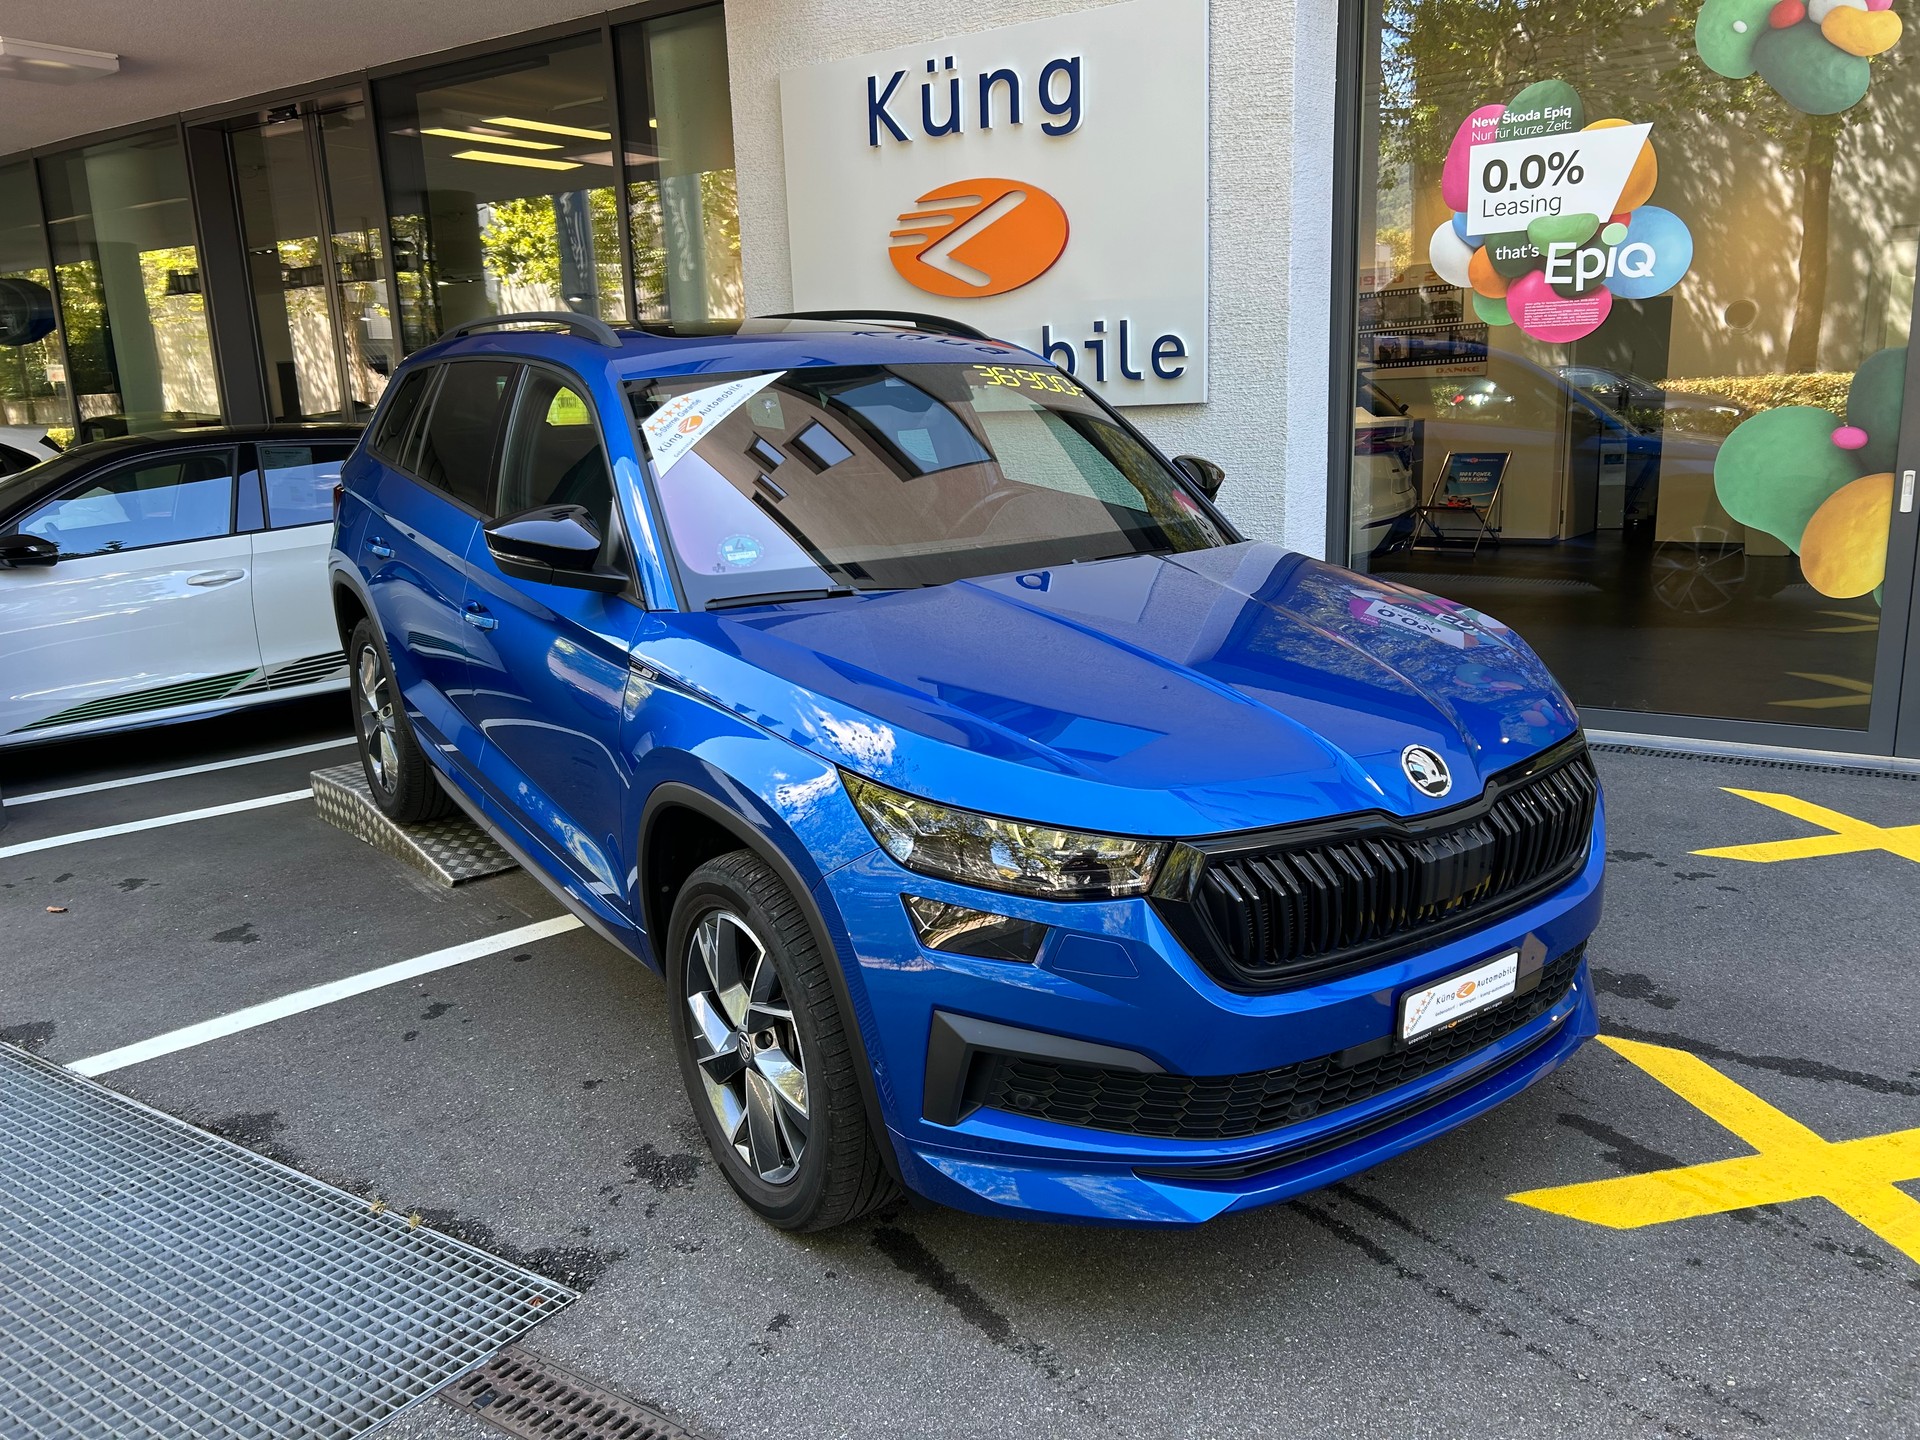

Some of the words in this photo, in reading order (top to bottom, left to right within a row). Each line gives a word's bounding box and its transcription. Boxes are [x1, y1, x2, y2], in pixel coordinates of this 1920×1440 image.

[866, 55, 1085, 147] Küng
[1472, 117, 1499, 128] New
[1502, 110, 1540, 124] Škoda
[1544, 106, 1572, 120] Epiq
[1472, 131, 1491, 142] Nur
[1495, 127, 1511, 139] für
[1513, 125, 1544, 137] kurze
[1546, 119, 1572, 132] Zeit:
[1482, 149, 1584, 194] 0.0%
[1482, 195, 1562, 218] Leasing
[1495, 243, 1540, 261] that's
[1435, 365, 1480, 374] DANKE
[657, 433, 684, 454] Küng
[698, 383, 743, 416] Automobile
[1435, 991, 1456, 1005] Küng
[1476, 965, 1516, 989] Automobile
